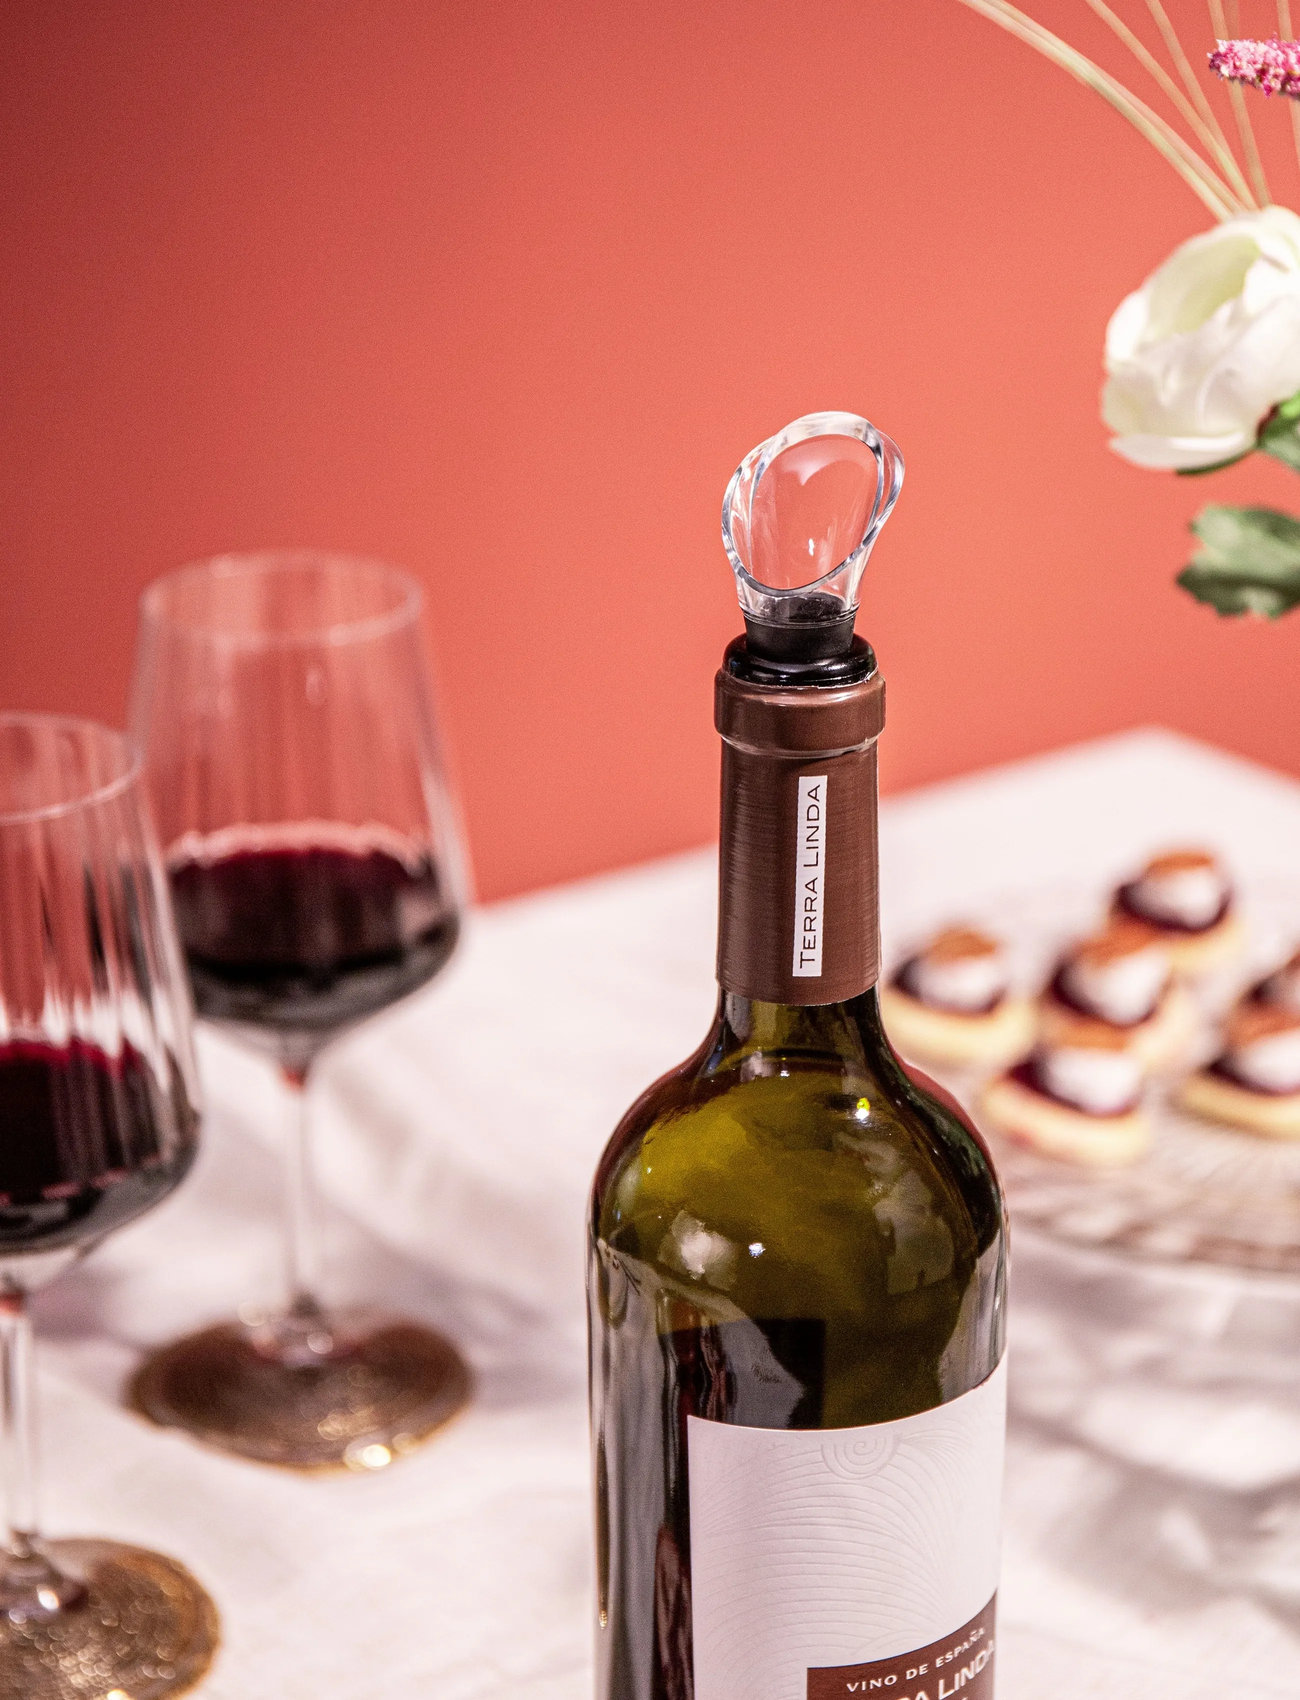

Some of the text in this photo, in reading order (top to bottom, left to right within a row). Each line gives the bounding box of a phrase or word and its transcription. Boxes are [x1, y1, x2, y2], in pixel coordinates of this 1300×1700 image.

[799, 784, 821, 969] TERRA LINDA
[846, 1627, 985, 1693] VINO DE ESPAÑA
[938, 1640, 995, 1700] LINDA
